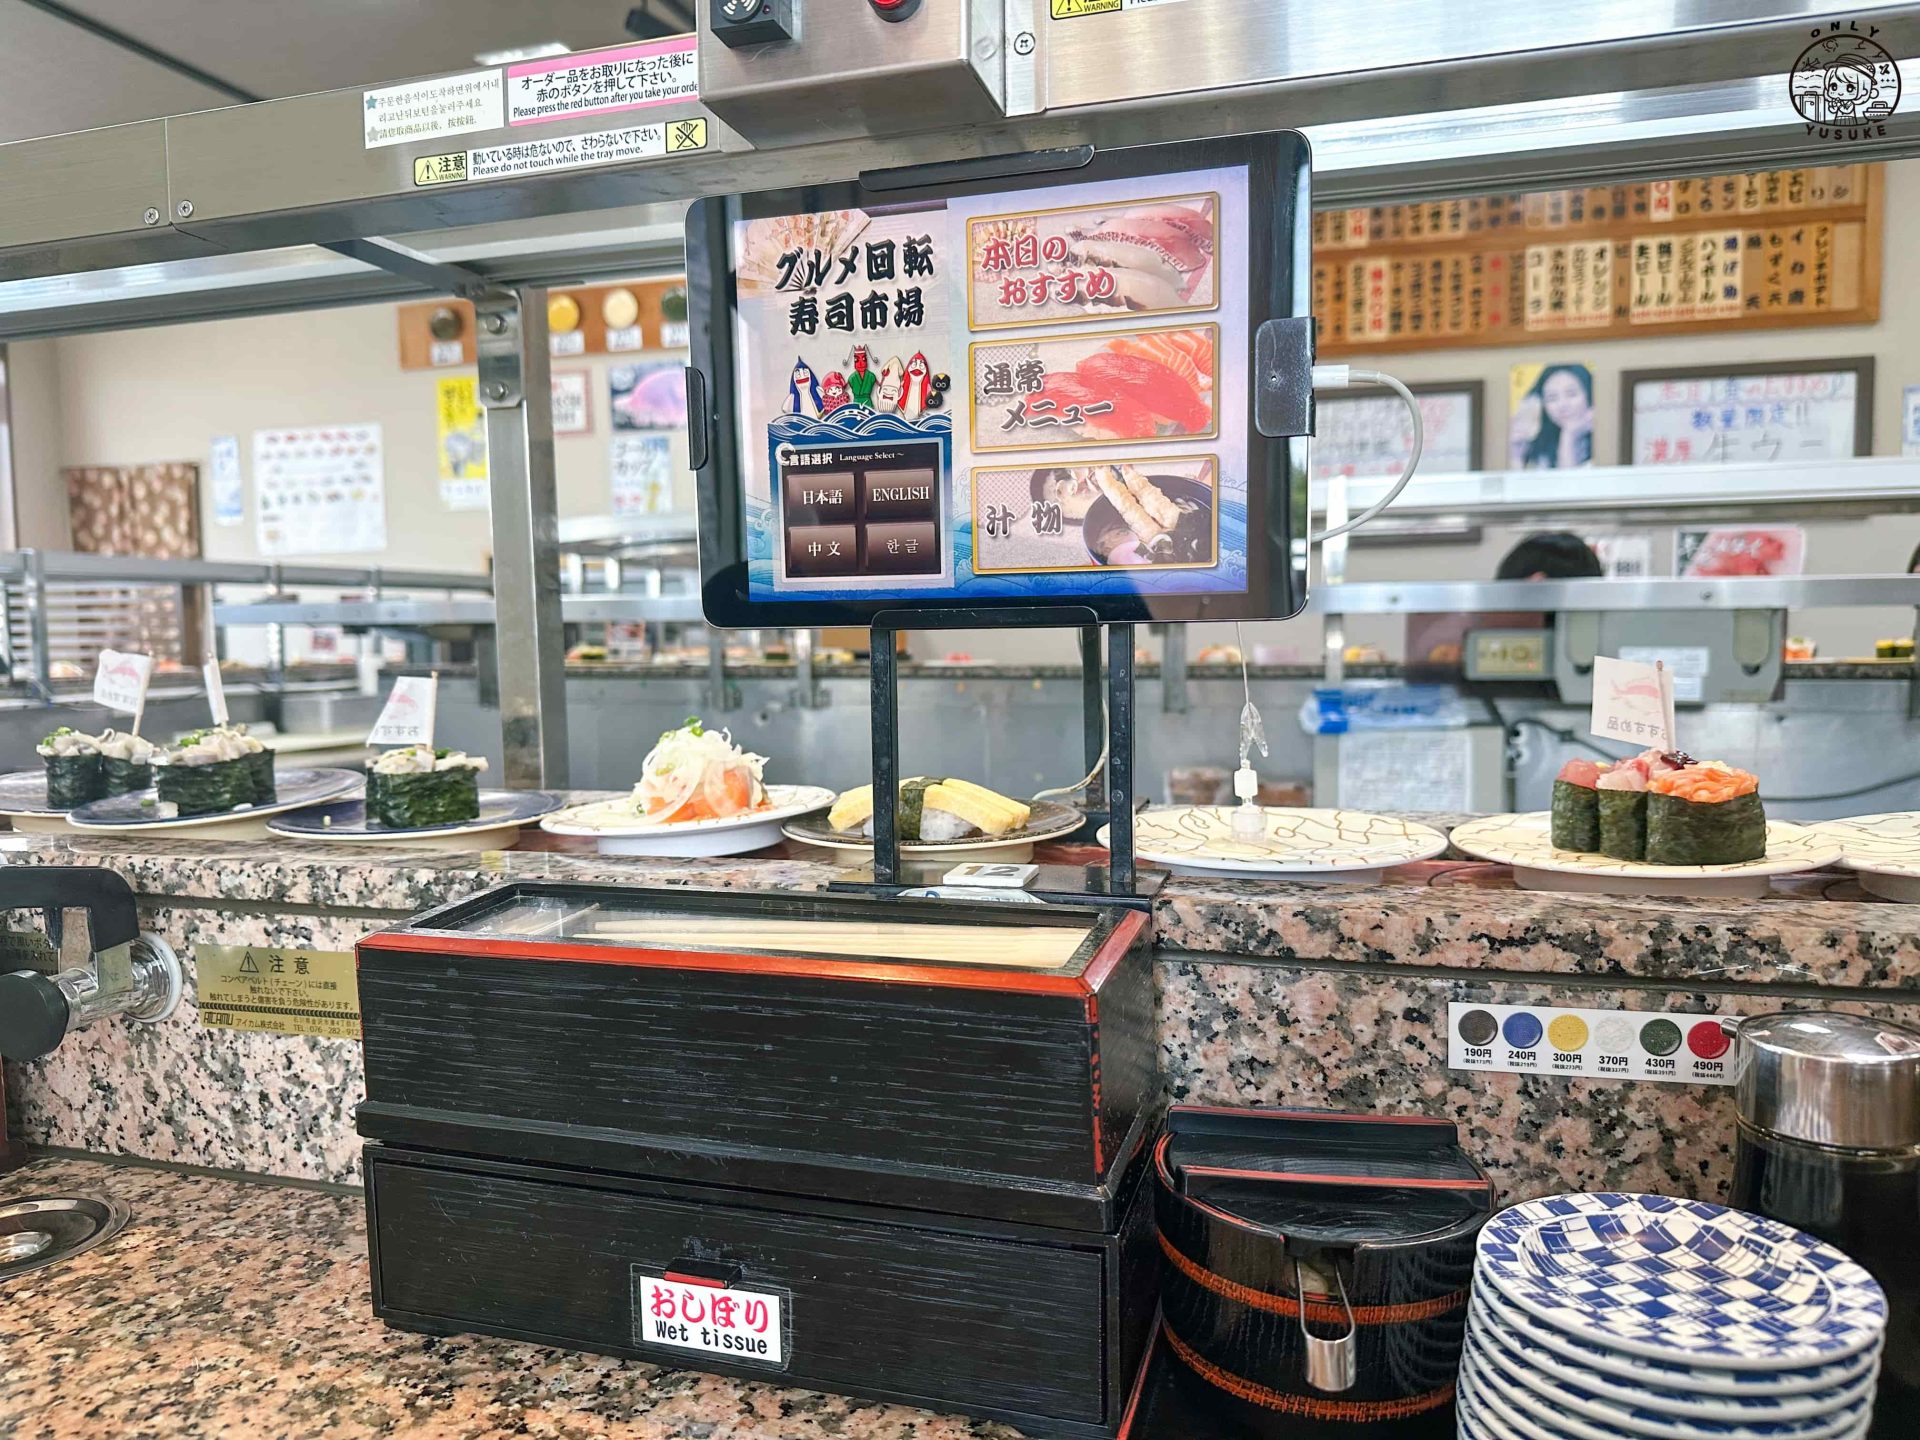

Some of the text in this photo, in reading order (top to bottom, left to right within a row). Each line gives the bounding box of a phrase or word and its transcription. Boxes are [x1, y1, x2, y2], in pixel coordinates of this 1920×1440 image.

[1083, 2, 1119, 12] WARNING
[521, 53, 694, 90] オーダー品をお取りになった後に
[536, 71, 677, 103] 赤のボタンを押して下さい。
[513, 106, 536, 118] Please
[537, 103, 556, 117] press
[557, 100, 569, 112] the
[570, 98, 583, 110] red
[584, 94, 609, 108] button
[610, 92, 628, 104] after
[629, 92, 644, 105] you
[645, 87, 661, 99] take
[662, 87, 680, 100] your
[473, 128, 661, 166] 動いている時は危ないので、さわらないで下さい。
[438, 154, 466, 173] 注意
[473, 146, 643, 176] Please do not touch while the tray move.
[439, 172, 466, 181] WARNING
[981, 236, 1068, 270] 本日の
[774, 233, 934, 293] グルメ回転
[998, 269, 1116, 307] おすすめ
[788, 287, 925, 337] 寿司市場
[982, 360, 1045, 397] 通常
[1000, 400, 1115, 432] メニュー
[789, 451, 895, 466] 言語選択 Language Select
[802, 489, 844, 506] 日本語
[872, 486, 930, 502] ENGLISH
[985, 501, 1064, 538] 汁物
[808, 540, 842, 557] 中文
[886, 538, 920, 554] 한글
[268, 954, 310, 975] 注意
[250, 986, 311, 997] 触れないで下さい。
[236, 1018, 286, 1030] アイカム株式会社
[1464, 1048, 1492, 1058] 190円
[1508, 1050, 1536, 1060] 240円
[1552, 1053, 1582, 1064] 300円
[1598, 1056, 1628, 1066] 370円
[1645, 1058, 1676, 1069] 430円
[1692, 1060, 1724, 1072] 490円
[650, 1284, 769, 1333] おしぼり
[655, 1320, 768, 1354] Wet tissue
